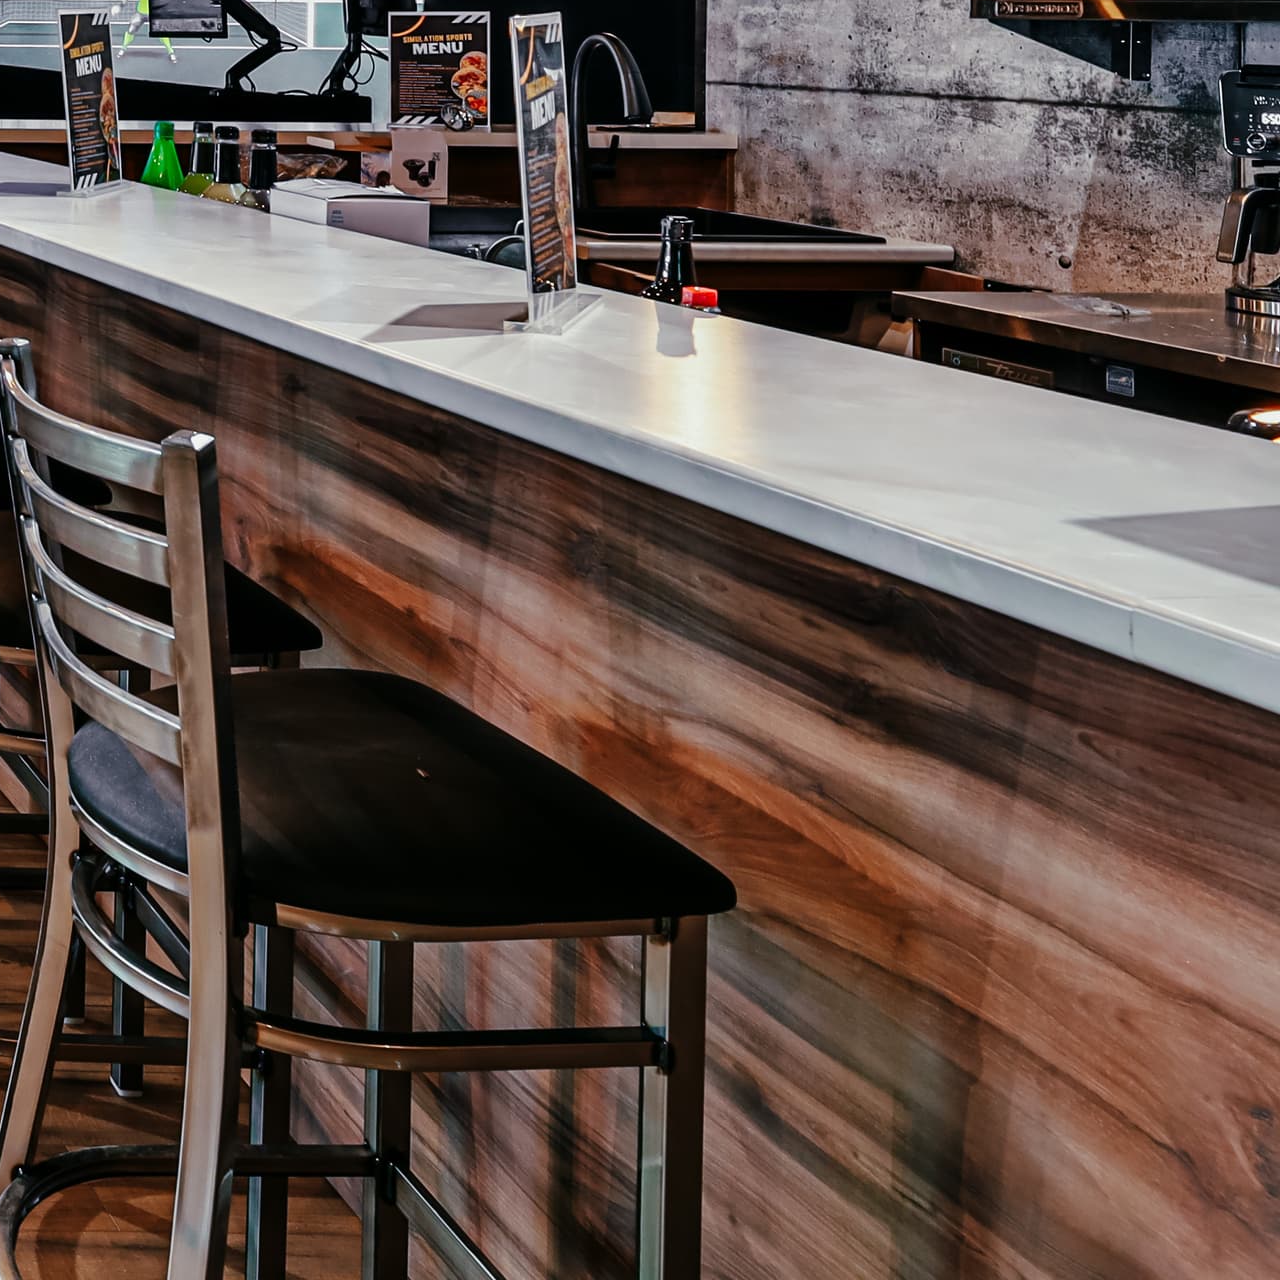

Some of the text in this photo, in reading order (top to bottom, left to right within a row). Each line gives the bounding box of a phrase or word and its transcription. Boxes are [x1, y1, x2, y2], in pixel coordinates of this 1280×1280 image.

[403, 33, 472, 43] SIMULATION SPORTS
[412, 41, 463, 55] MENU
[75, 54, 102, 78] MENU
[531, 90, 556, 130] MENU
